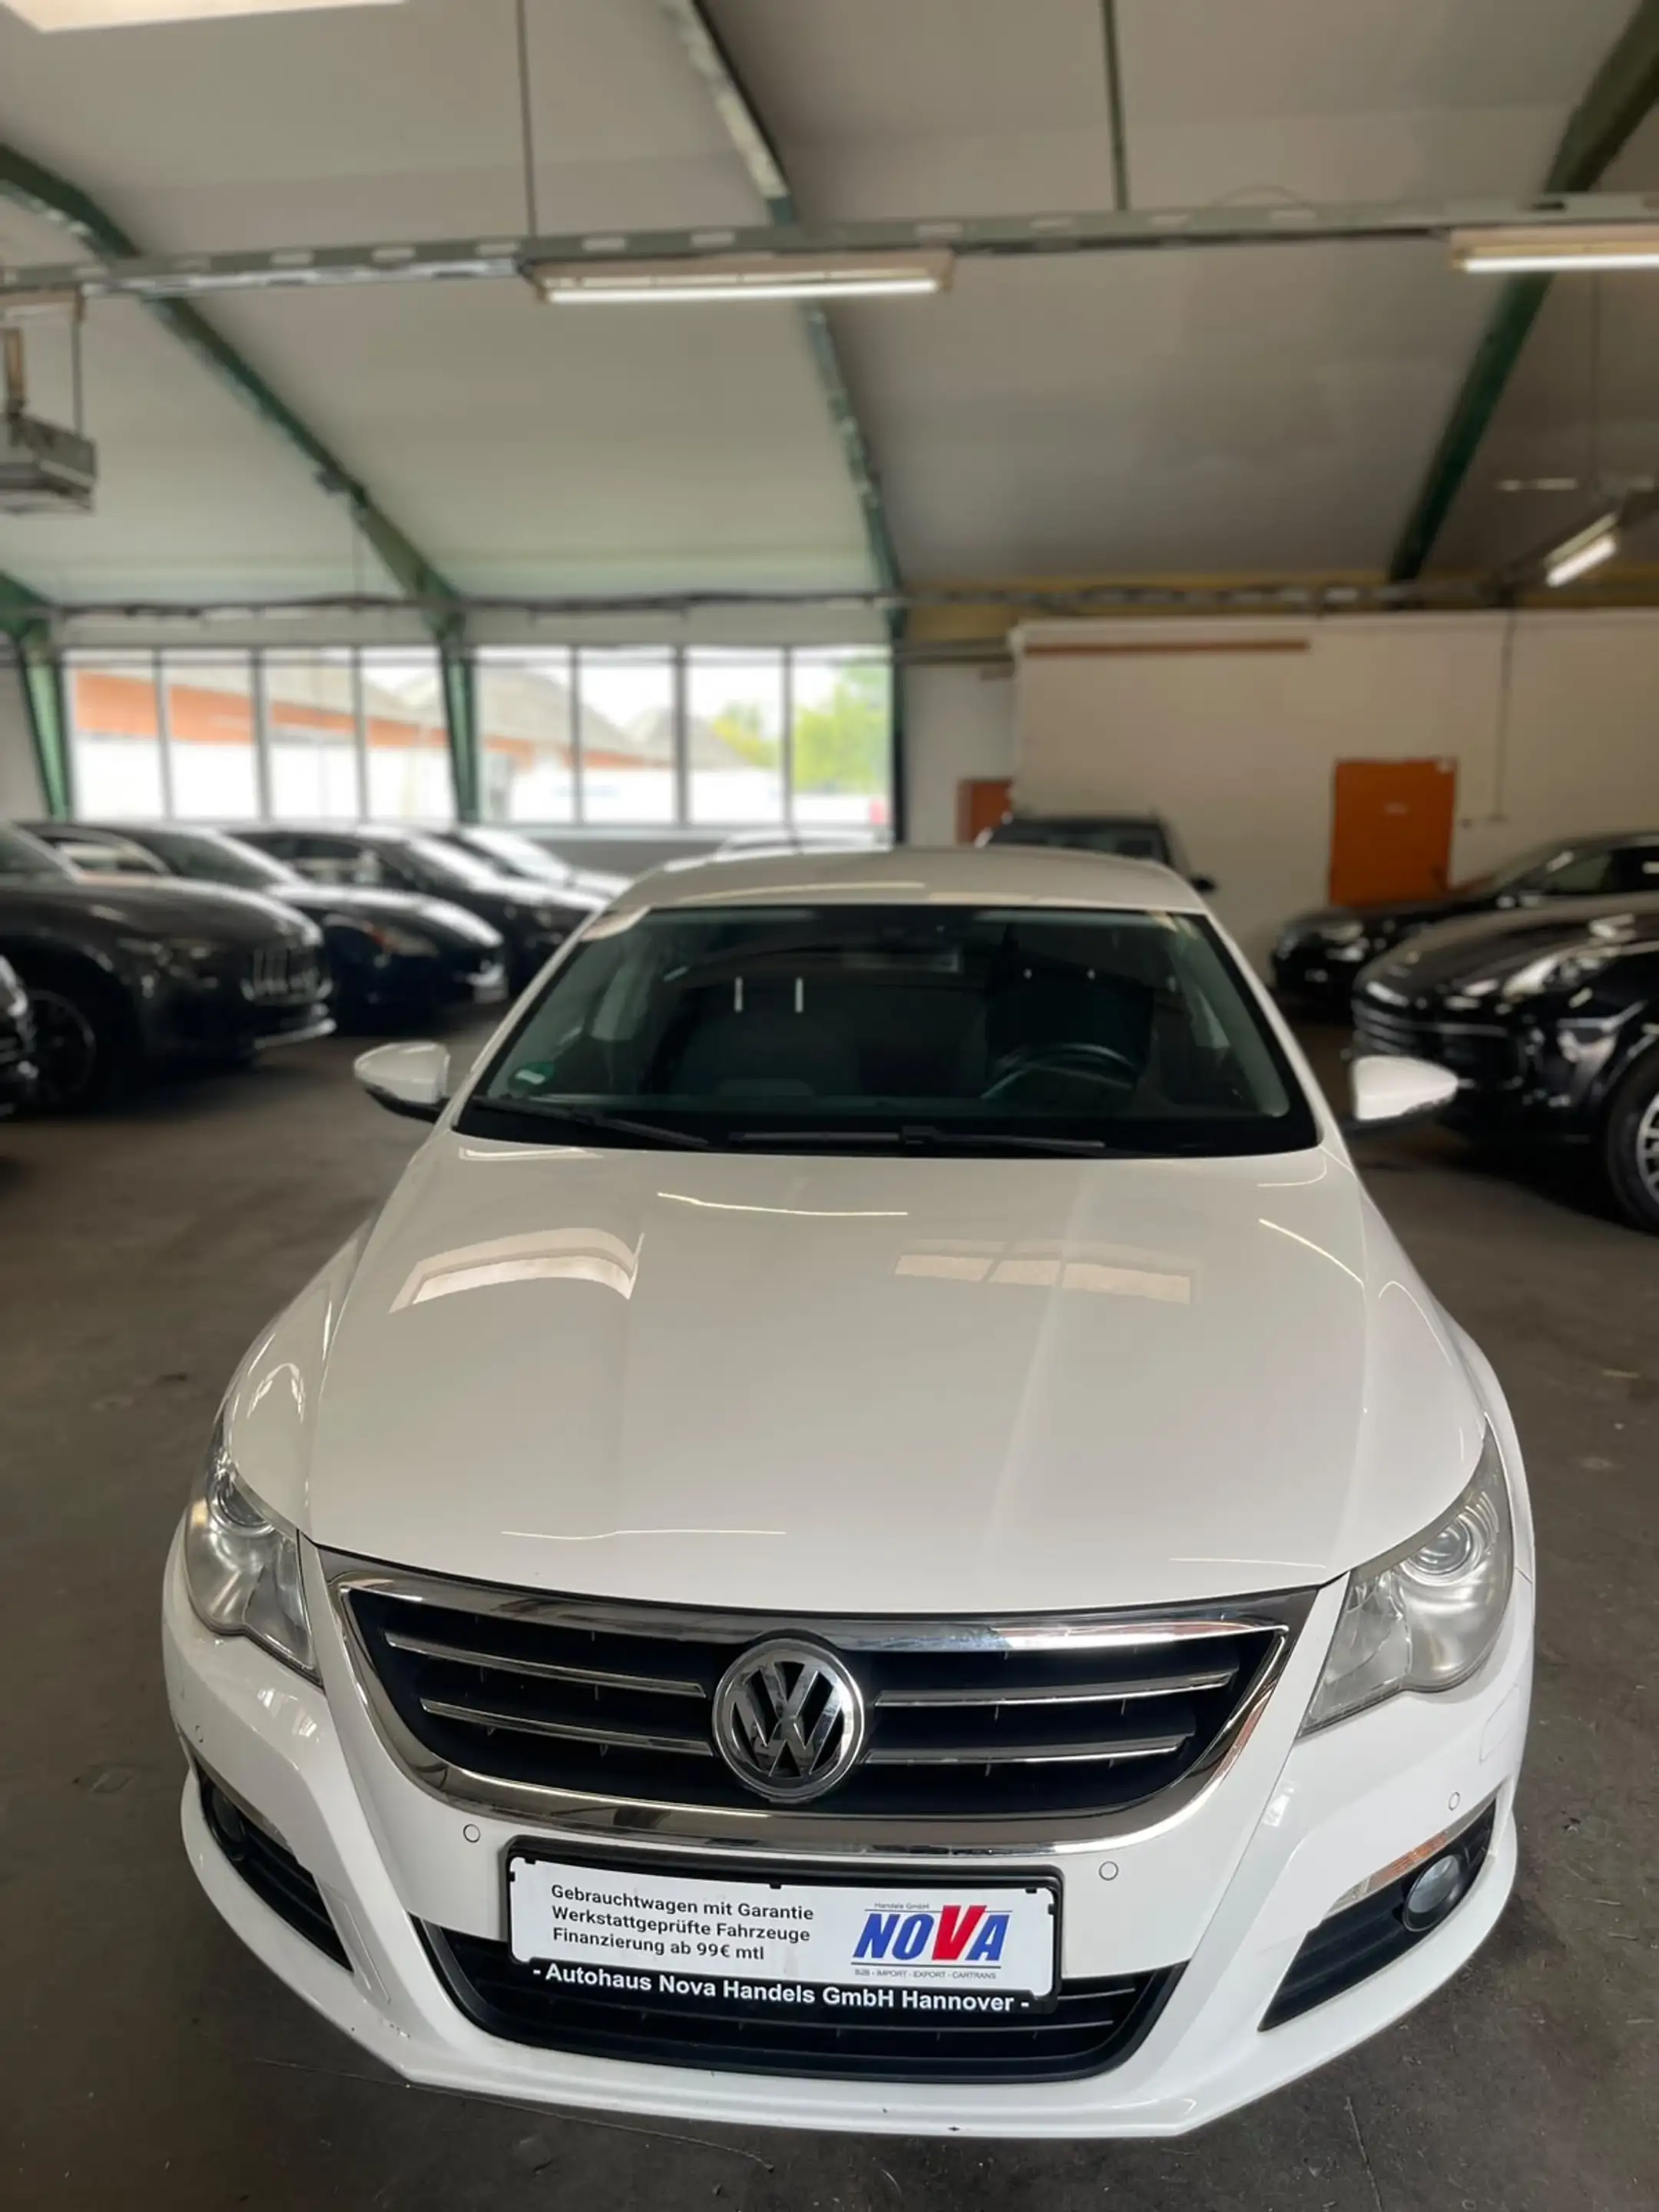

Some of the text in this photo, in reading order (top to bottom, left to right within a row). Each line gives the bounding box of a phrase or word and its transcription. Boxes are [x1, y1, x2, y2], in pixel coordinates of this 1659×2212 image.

[551, 1884, 814, 1920] Gebrauchtwagen mit Garantie
[551, 1905, 810, 1944] Werkstattgeprüfte Fahrzeuge
[552, 1926, 765, 1960] Finanzierung ab 99€ mtl
[853, 1905, 1011, 1962] NOVA
[545, 1962, 652, 1992] Autohaus
[658, 1974, 717, 1997] Nova
[723, 1979, 816, 2004] Handels
[822, 1985, 895, 2008] GmbH
[901, 1989, 1015, 2012] Hannover
[876, 1970, 907, 1979] IMPORT
[912, 1970, 946, 1979] EXPORT
[952, 1971, 997, 1980] CARTRANS
